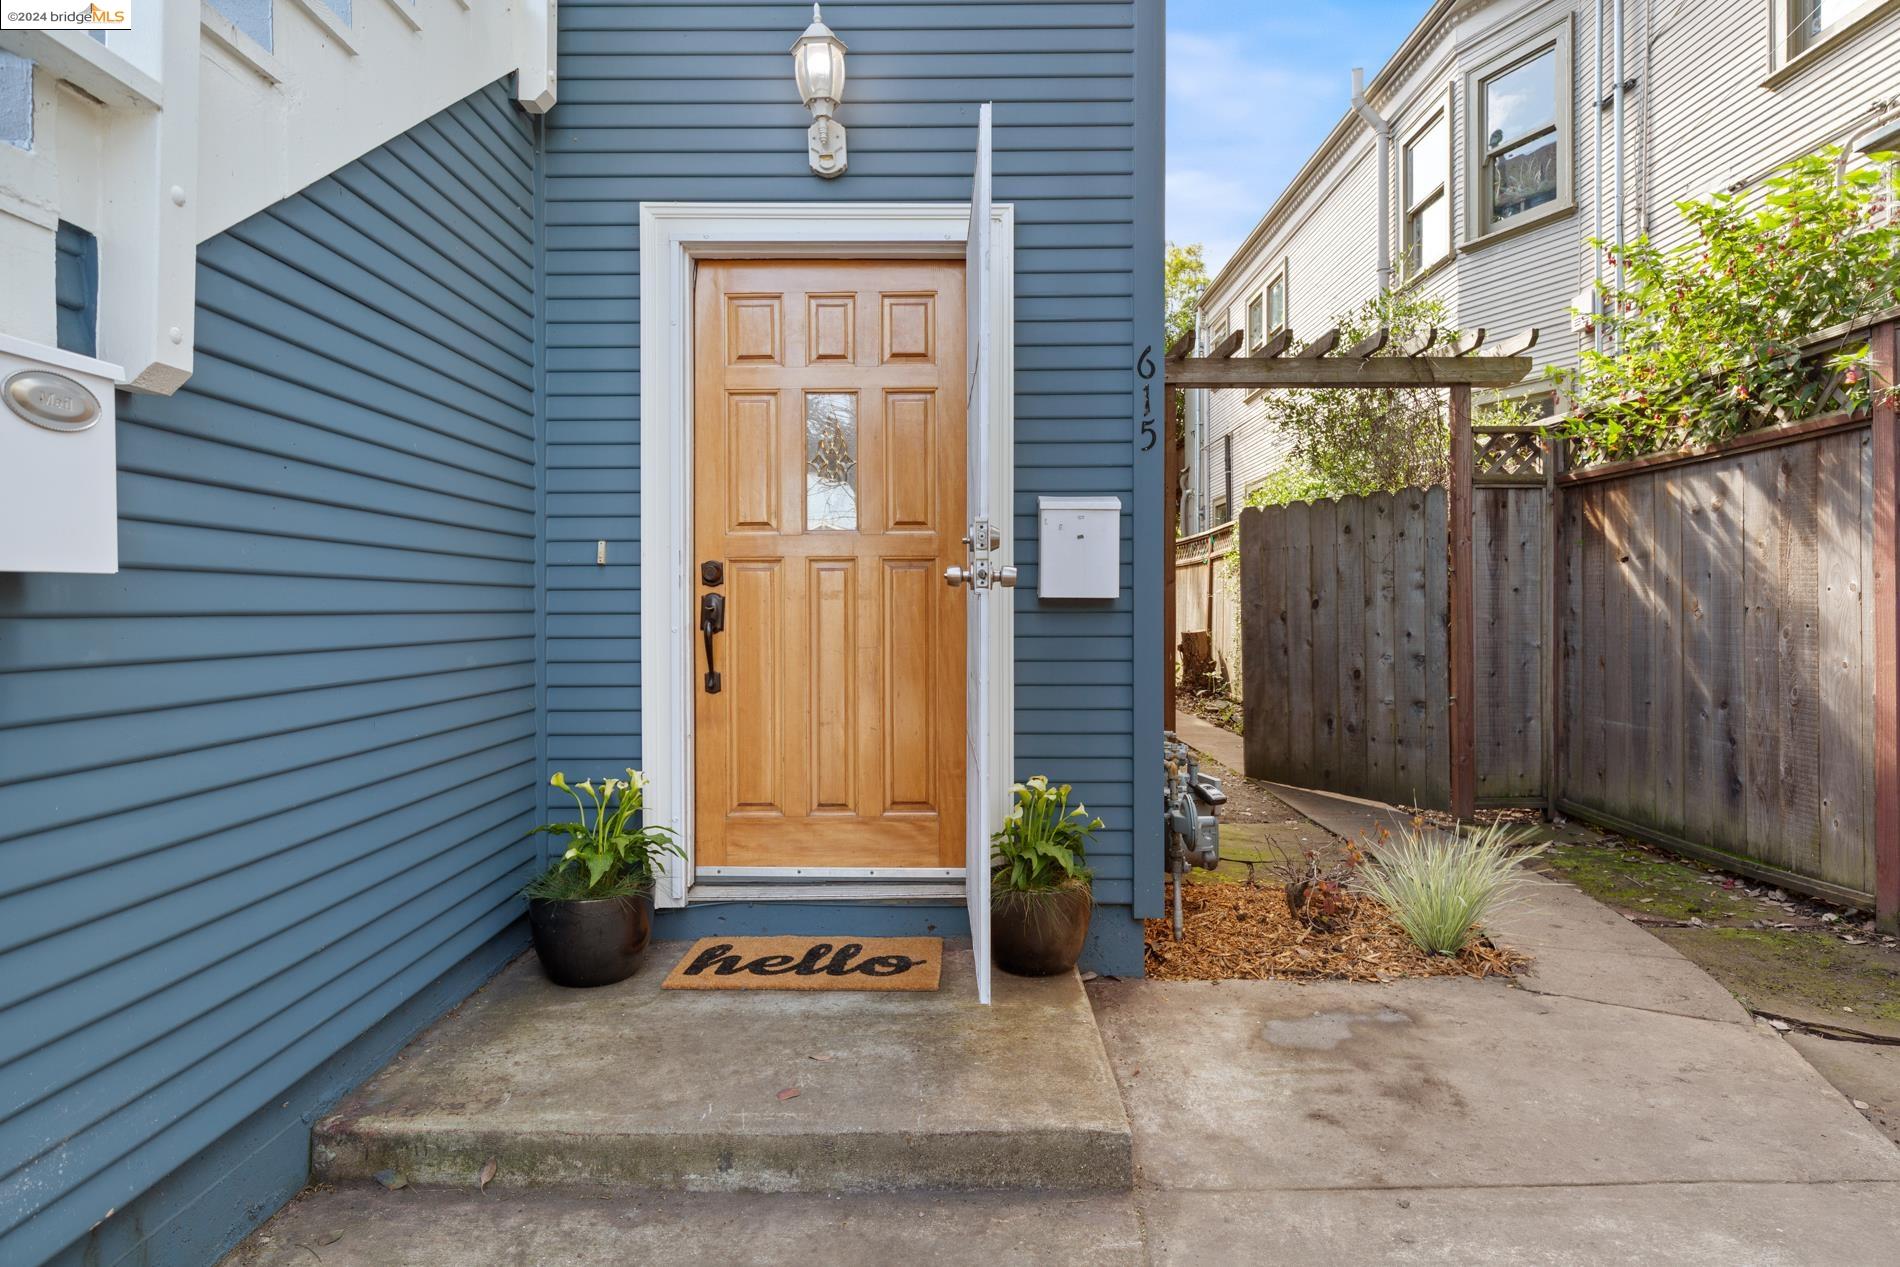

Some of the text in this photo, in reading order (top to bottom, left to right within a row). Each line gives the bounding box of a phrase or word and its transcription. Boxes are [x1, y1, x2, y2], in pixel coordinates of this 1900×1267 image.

[40, 391, 73, 412] Mail
[1137, 345, 1157, 452] 615
[682, 943, 927, 977] hello
